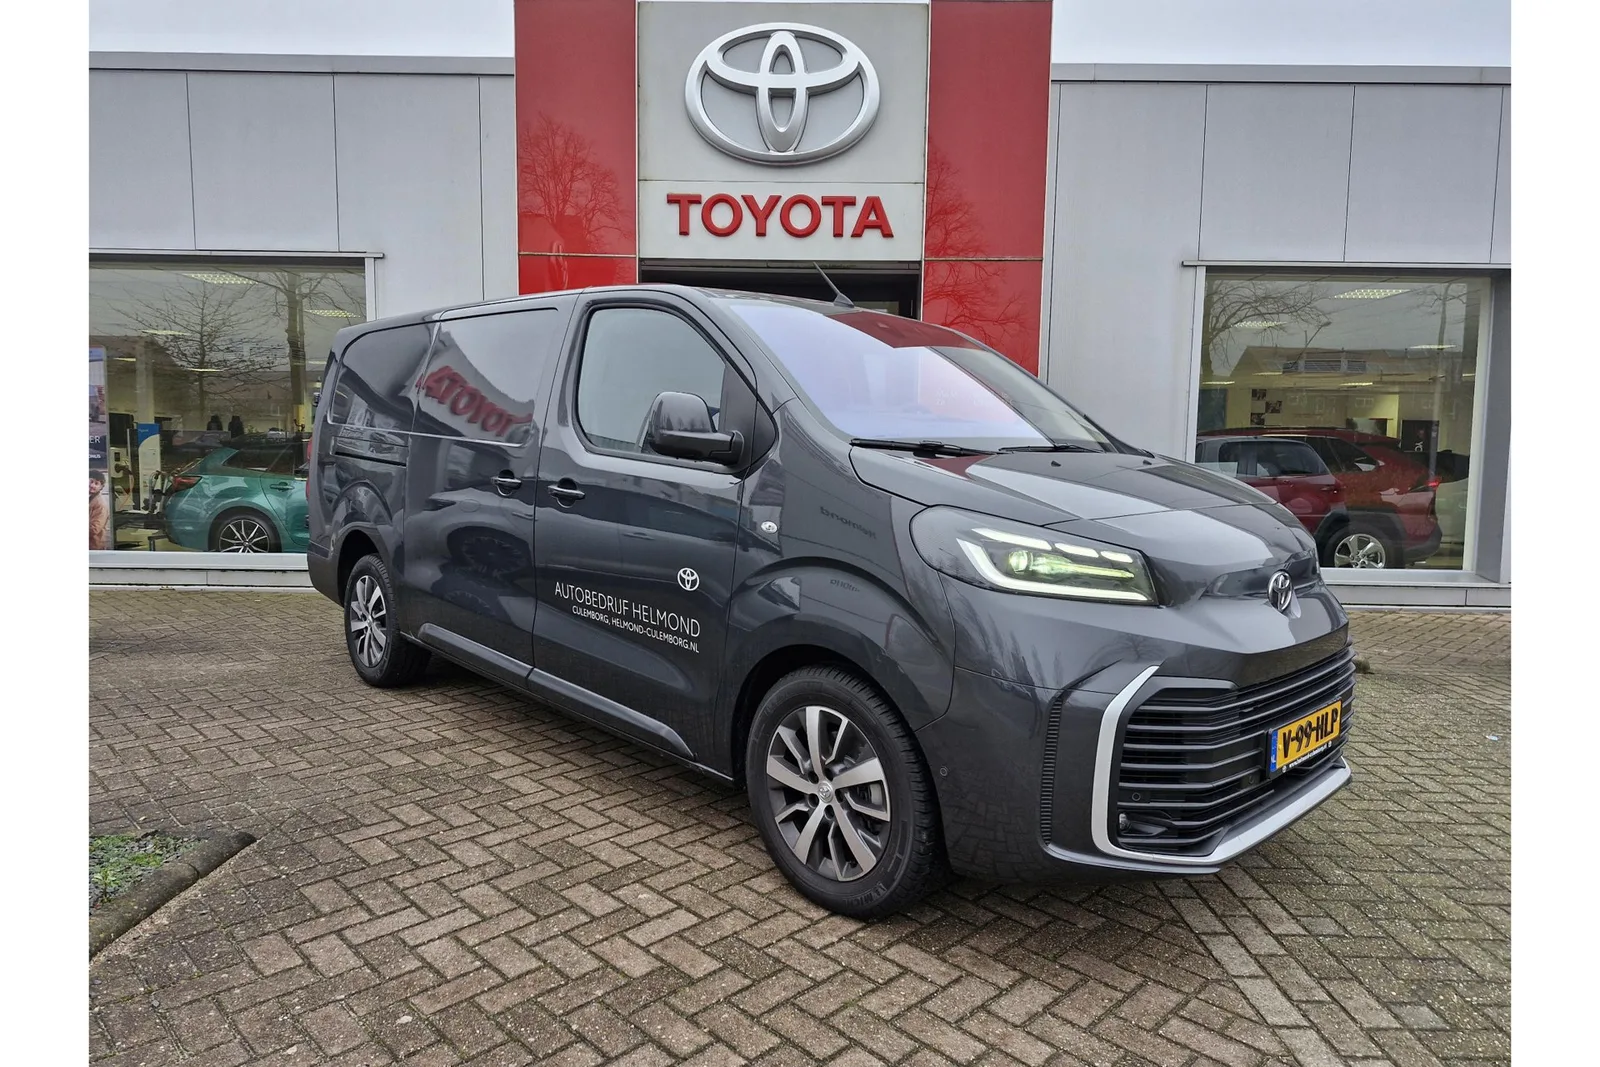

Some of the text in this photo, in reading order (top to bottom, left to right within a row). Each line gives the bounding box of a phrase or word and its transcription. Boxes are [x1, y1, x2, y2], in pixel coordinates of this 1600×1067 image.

[666, 193, 894, 238] TOYOTA
[554, 581, 701, 638] AUTOBEDRIJF HELMOND
[572, 605, 700, 654] CULEMBORG, HELMOND-CULEMBORG.NL
[1283, 708, 1338, 758] V-99-HLP
